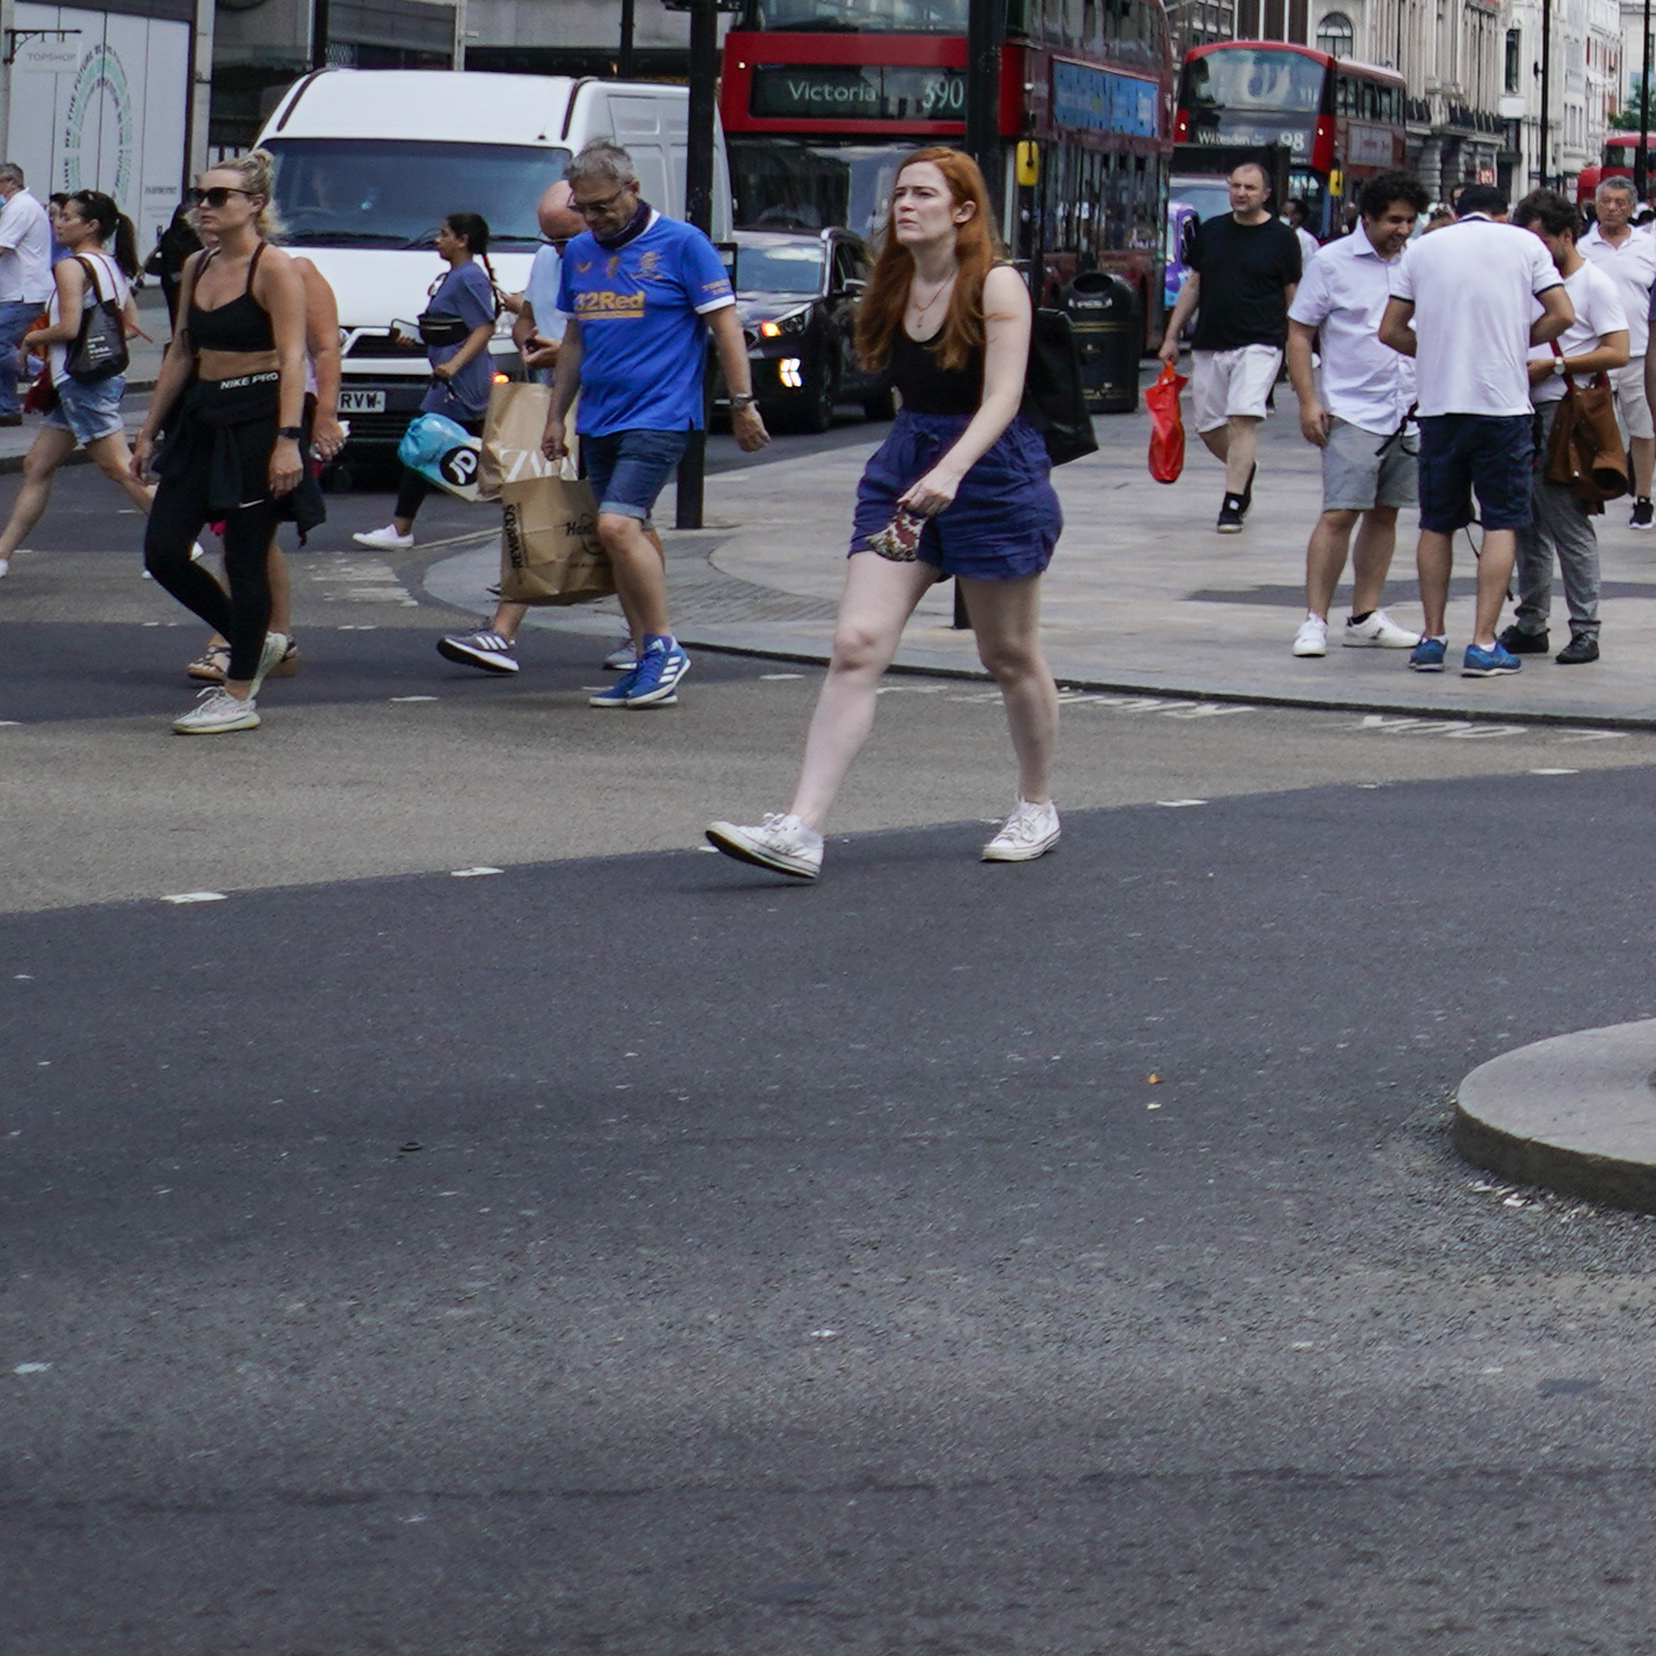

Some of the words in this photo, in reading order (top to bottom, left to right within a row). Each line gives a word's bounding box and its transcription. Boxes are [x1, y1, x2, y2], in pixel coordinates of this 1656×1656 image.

[27, 52, 76, 62] TOPSHOP
[788, 80, 877, 102] Victoria
[1279, 130, 1305, 151] 98
[221, 376, 249, 390] NIKE
[252, 372, 279, 385] PRO
[448, 448, 478, 484] JD
